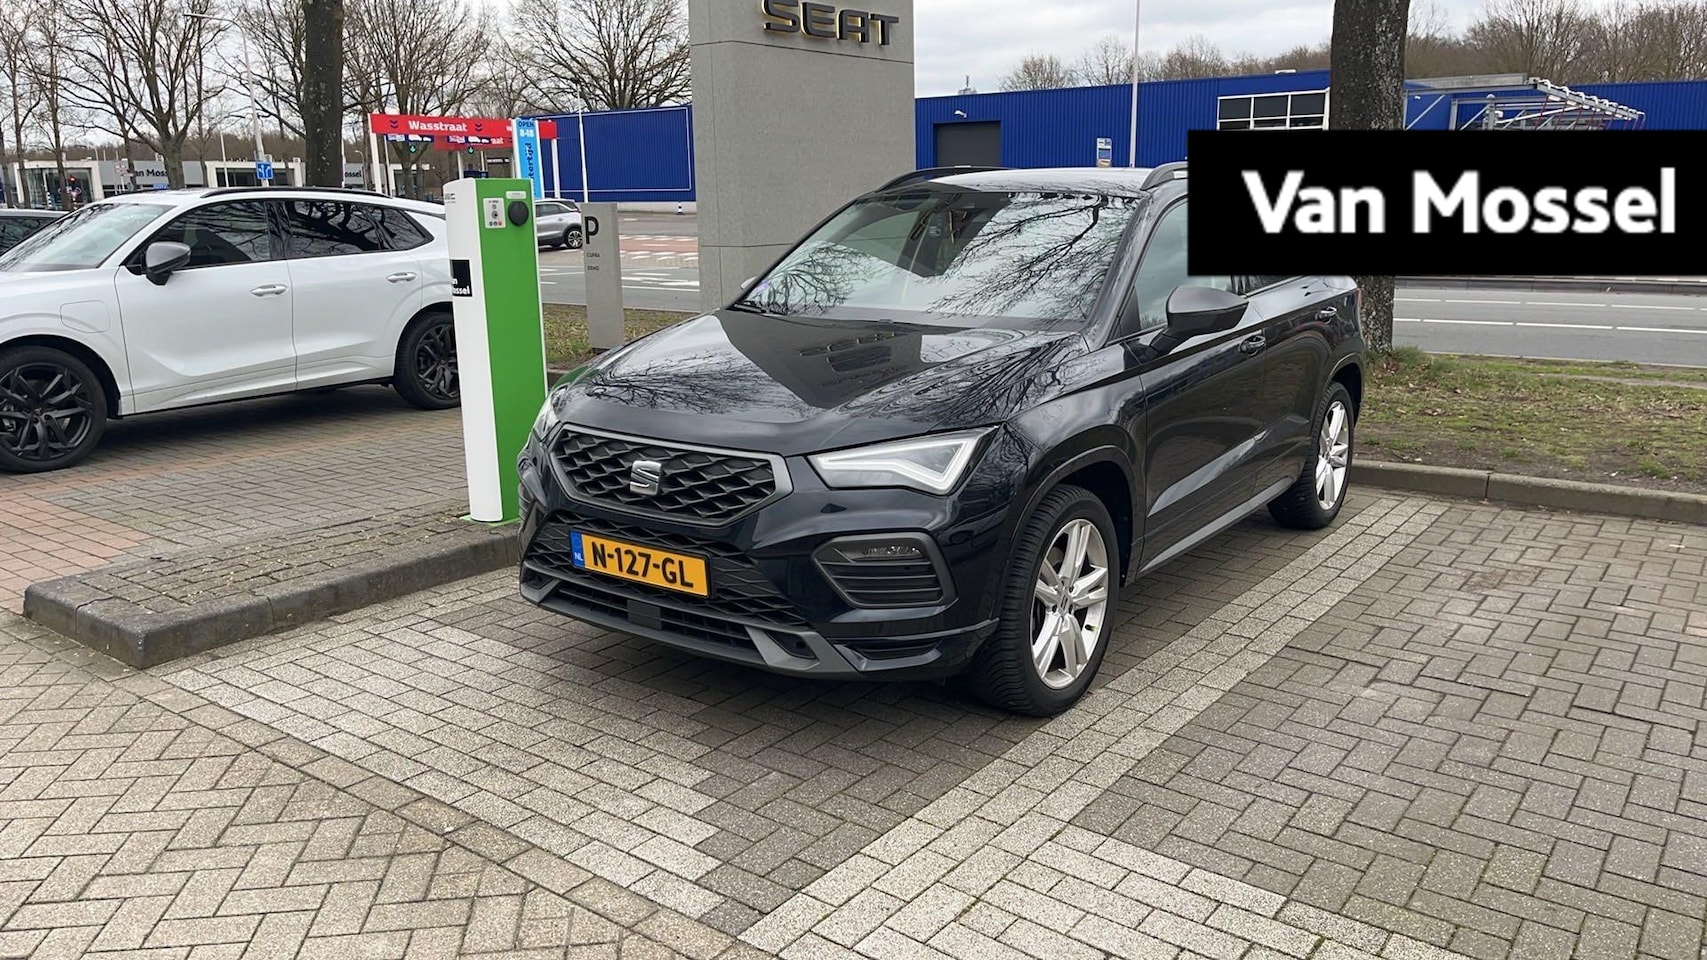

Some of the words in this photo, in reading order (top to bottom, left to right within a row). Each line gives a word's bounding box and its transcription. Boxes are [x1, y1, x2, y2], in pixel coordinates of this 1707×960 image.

[762, 0, 899, 46] SEAT
[408, 120, 468, 132] Wasstraat
[520, 129, 535, 138] 8-18
[146, 169, 169, 177] Moss
[344, 169, 362, 177] ossel
[584, 216, 599, 244] P
[574, 552, 584, 561] NL
[591, 541, 694, 588] N-127-GL
